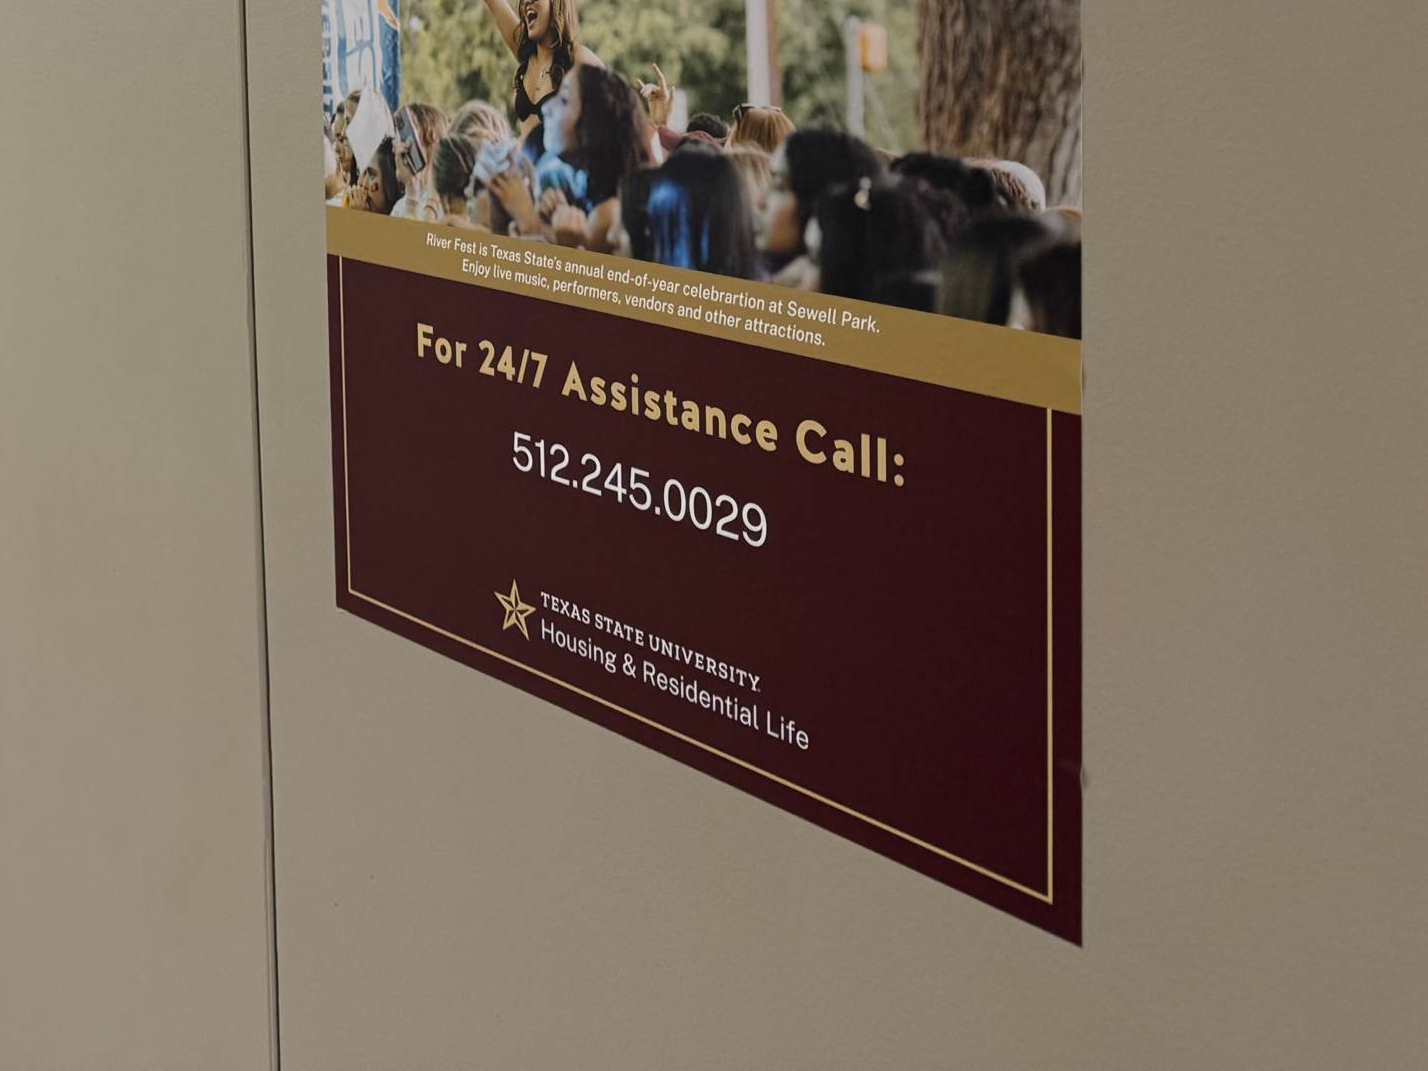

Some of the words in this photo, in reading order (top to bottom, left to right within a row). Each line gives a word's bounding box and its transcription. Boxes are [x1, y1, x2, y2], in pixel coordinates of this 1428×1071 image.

[426, 232, 452, 250] River
[454, 237, 476, 255] Fest
[479, 244, 488, 257] is
[491, 244, 521, 263] Texas
[523, 251, 562, 271] State's
[564, 259, 604, 279] annual
[607, 268, 680, 294] end-of-year
[682, 284, 765, 310] celebrartion
[768, 300, 783, 315] at
[787, 300, 836, 325] Sewell
[841, 311, 881, 333] Park.
[462, 258, 491, 278] Enjoy
[493, 264, 512, 280] live
[514, 270, 550, 290] music,
[552, 278, 621, 305] performers,
[624, 294, 674, 315] vendors
[677, 303, 702, 321] and
[704, 310, 742, 329] other
[744, 317, 826, 346] attractions.
[416, 322, 467, 368] For
[478, 340, 548, 389] 24/7
[561, 360, 779, 452] Assistance
[795, 419, 905, 487] Call:
[512, 430, 768, 548] 512.245.0029
[540, 591, 591, 625] TEXAS
[594, 613, 645, 647] STATE
[648, 634, 760, 692] UNIVERSITY
[540, 618, 617, 674] Housing
[622, 653, 637, 678] &
[643, 660, 759, 730] Residential
[766, 710, 810, 750] Life
